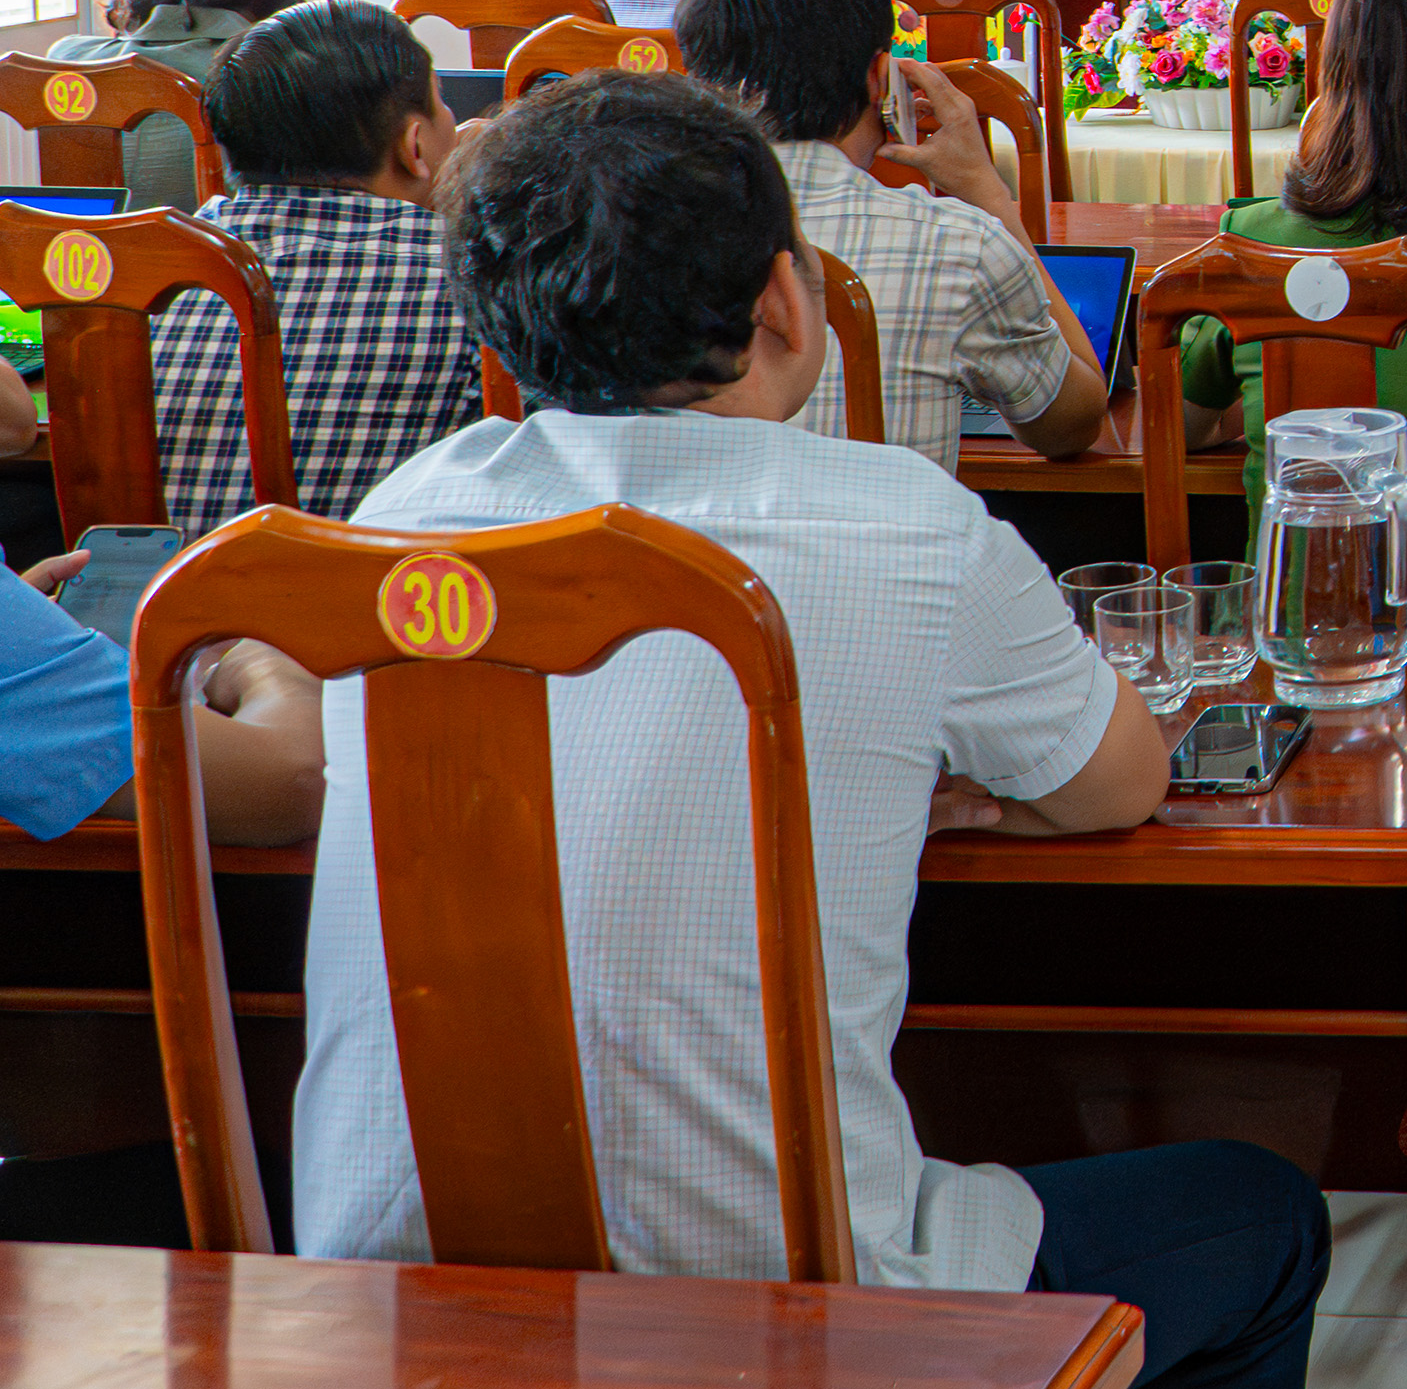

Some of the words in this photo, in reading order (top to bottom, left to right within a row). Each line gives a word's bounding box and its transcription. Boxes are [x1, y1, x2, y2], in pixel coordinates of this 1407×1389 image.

[629, 45, 657, 73] 52
[52, 80, 87, 115] 92
[54, 240, 99, 291] 102
[402, 572, 471, 647] 30
